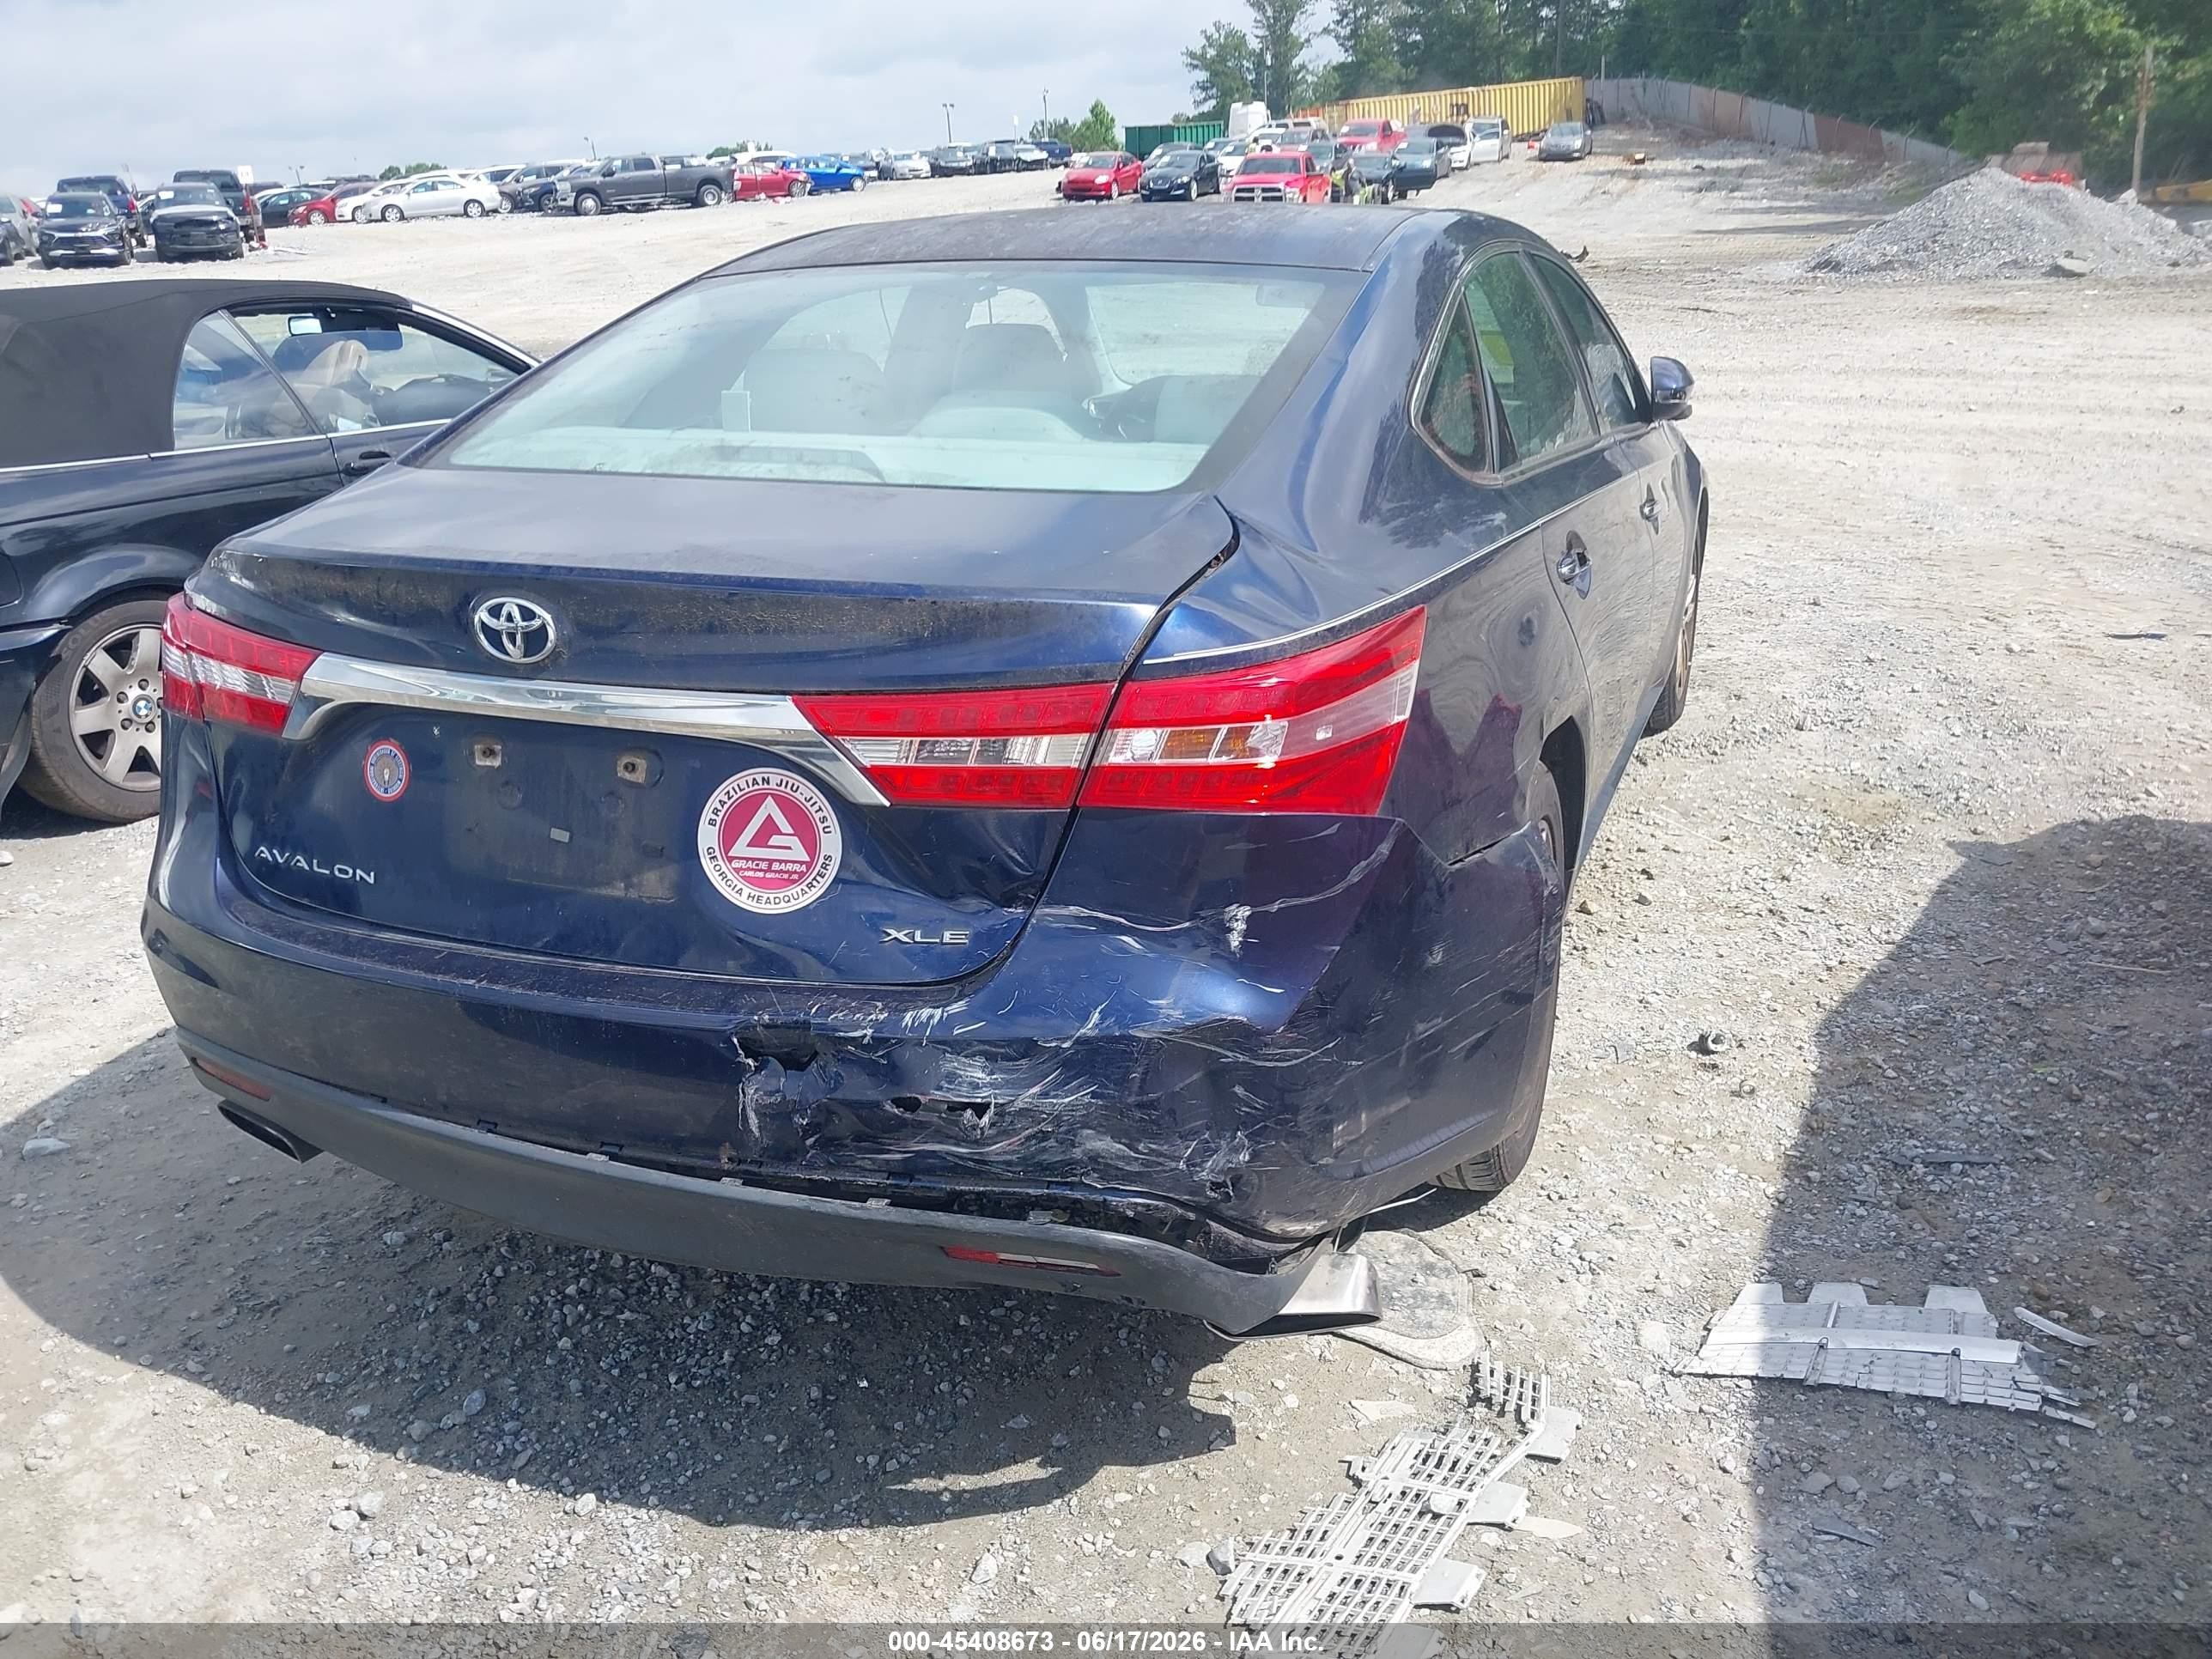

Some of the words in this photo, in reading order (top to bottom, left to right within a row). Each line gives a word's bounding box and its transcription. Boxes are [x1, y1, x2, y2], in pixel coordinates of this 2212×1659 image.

[708, 776, 770, 827] BRAZILIAN
[775, 777, 832, 835] JIU-JITSU
[255, 846, 374, 884] AVALON
[706, 846, 743, 896] GEORGIA
[746, 854, 833, 906] HEADQUARTERS
[731, 860, 769, 870] GRACIE
[771, 861, 807, 872] BARRA
[879, 928, 969, 945] XLE
